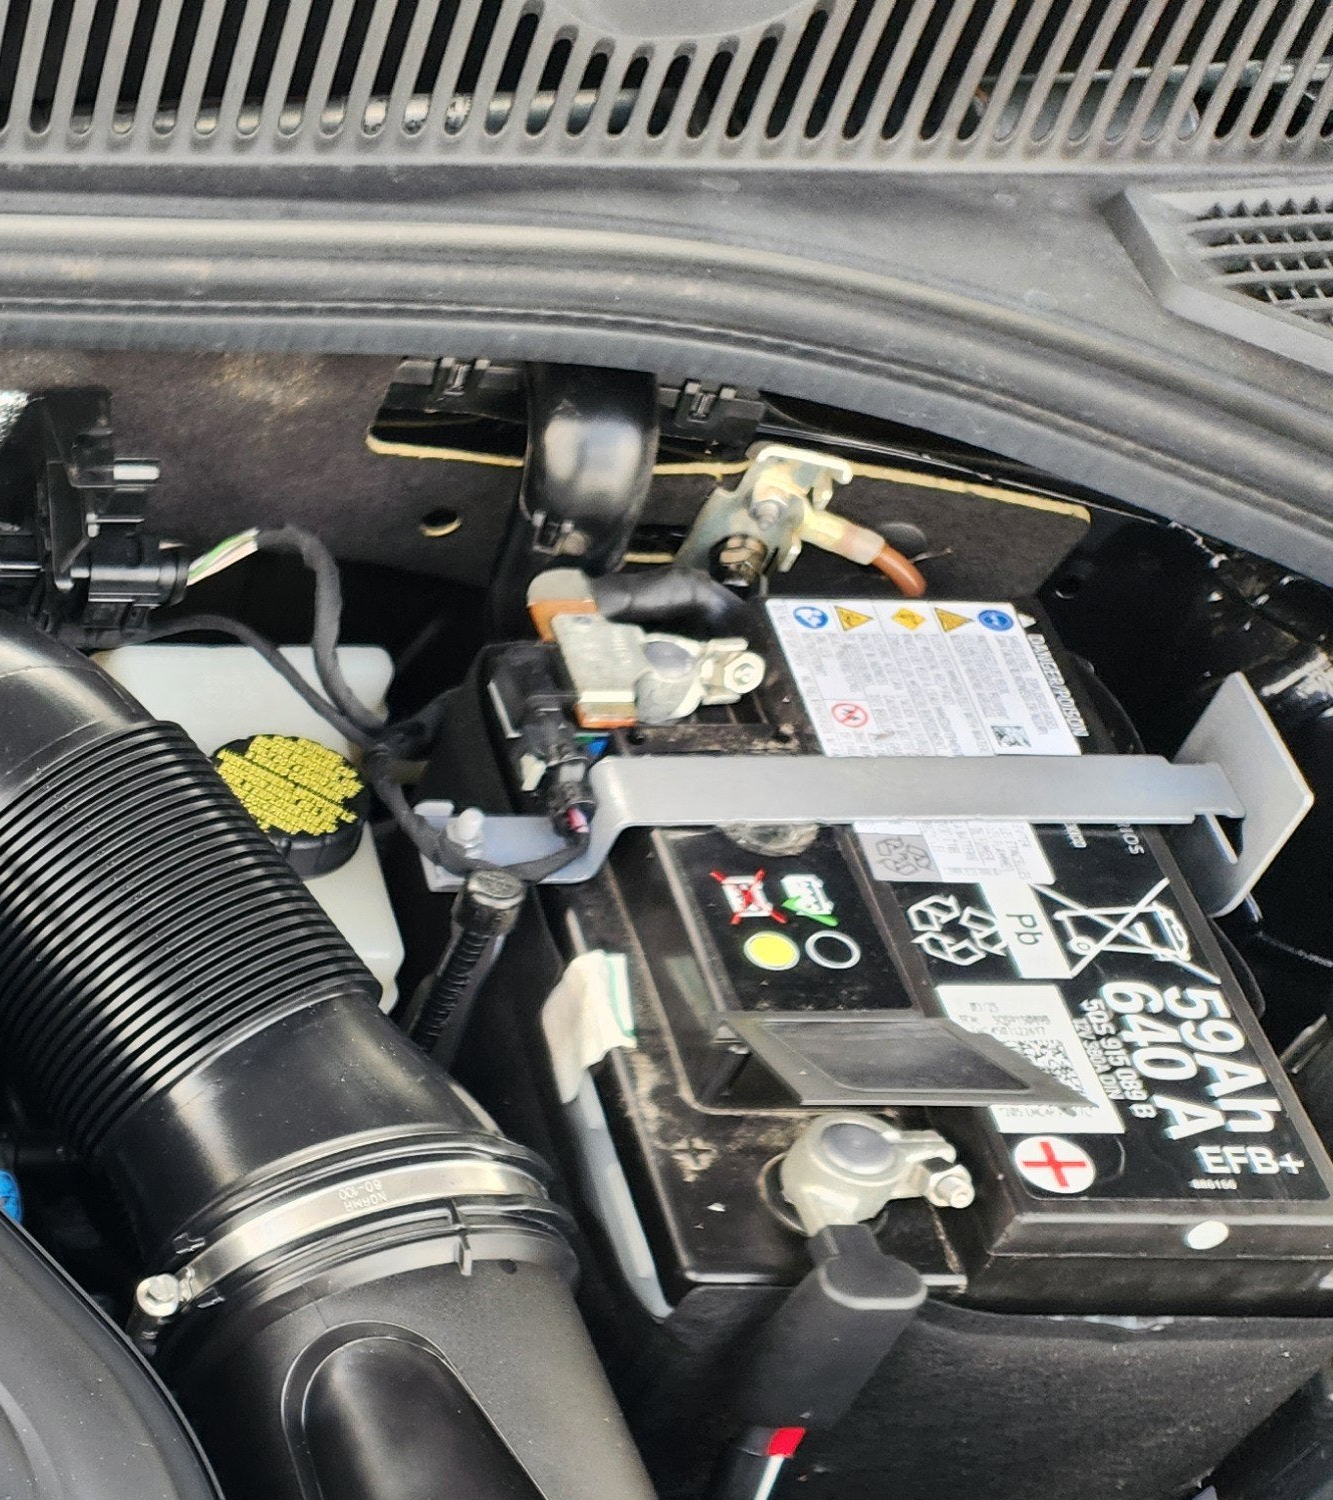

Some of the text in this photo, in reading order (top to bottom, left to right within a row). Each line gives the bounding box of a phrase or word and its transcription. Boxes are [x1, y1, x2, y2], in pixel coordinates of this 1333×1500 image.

[1028, 633, 1089, 737] DANGER/POISON
[1005, 913, 1044, 946] Pb
[1099, 981, 1198, 1081] 640
[1151, 1094, 1225, 1141] A
[1162, 985, 1282, 1133] 59Ah
[1098, 1073, 1125, 1100] DIN
[1100, 1037, 1131, 1067] 915
[1129, 1103, 1158, 1119] B
[1194, 1144, 1305, 1175] EFB+
[338, 1179, 382, 1200] 80-100
[344, 1191, 388, 1212] NORMA
